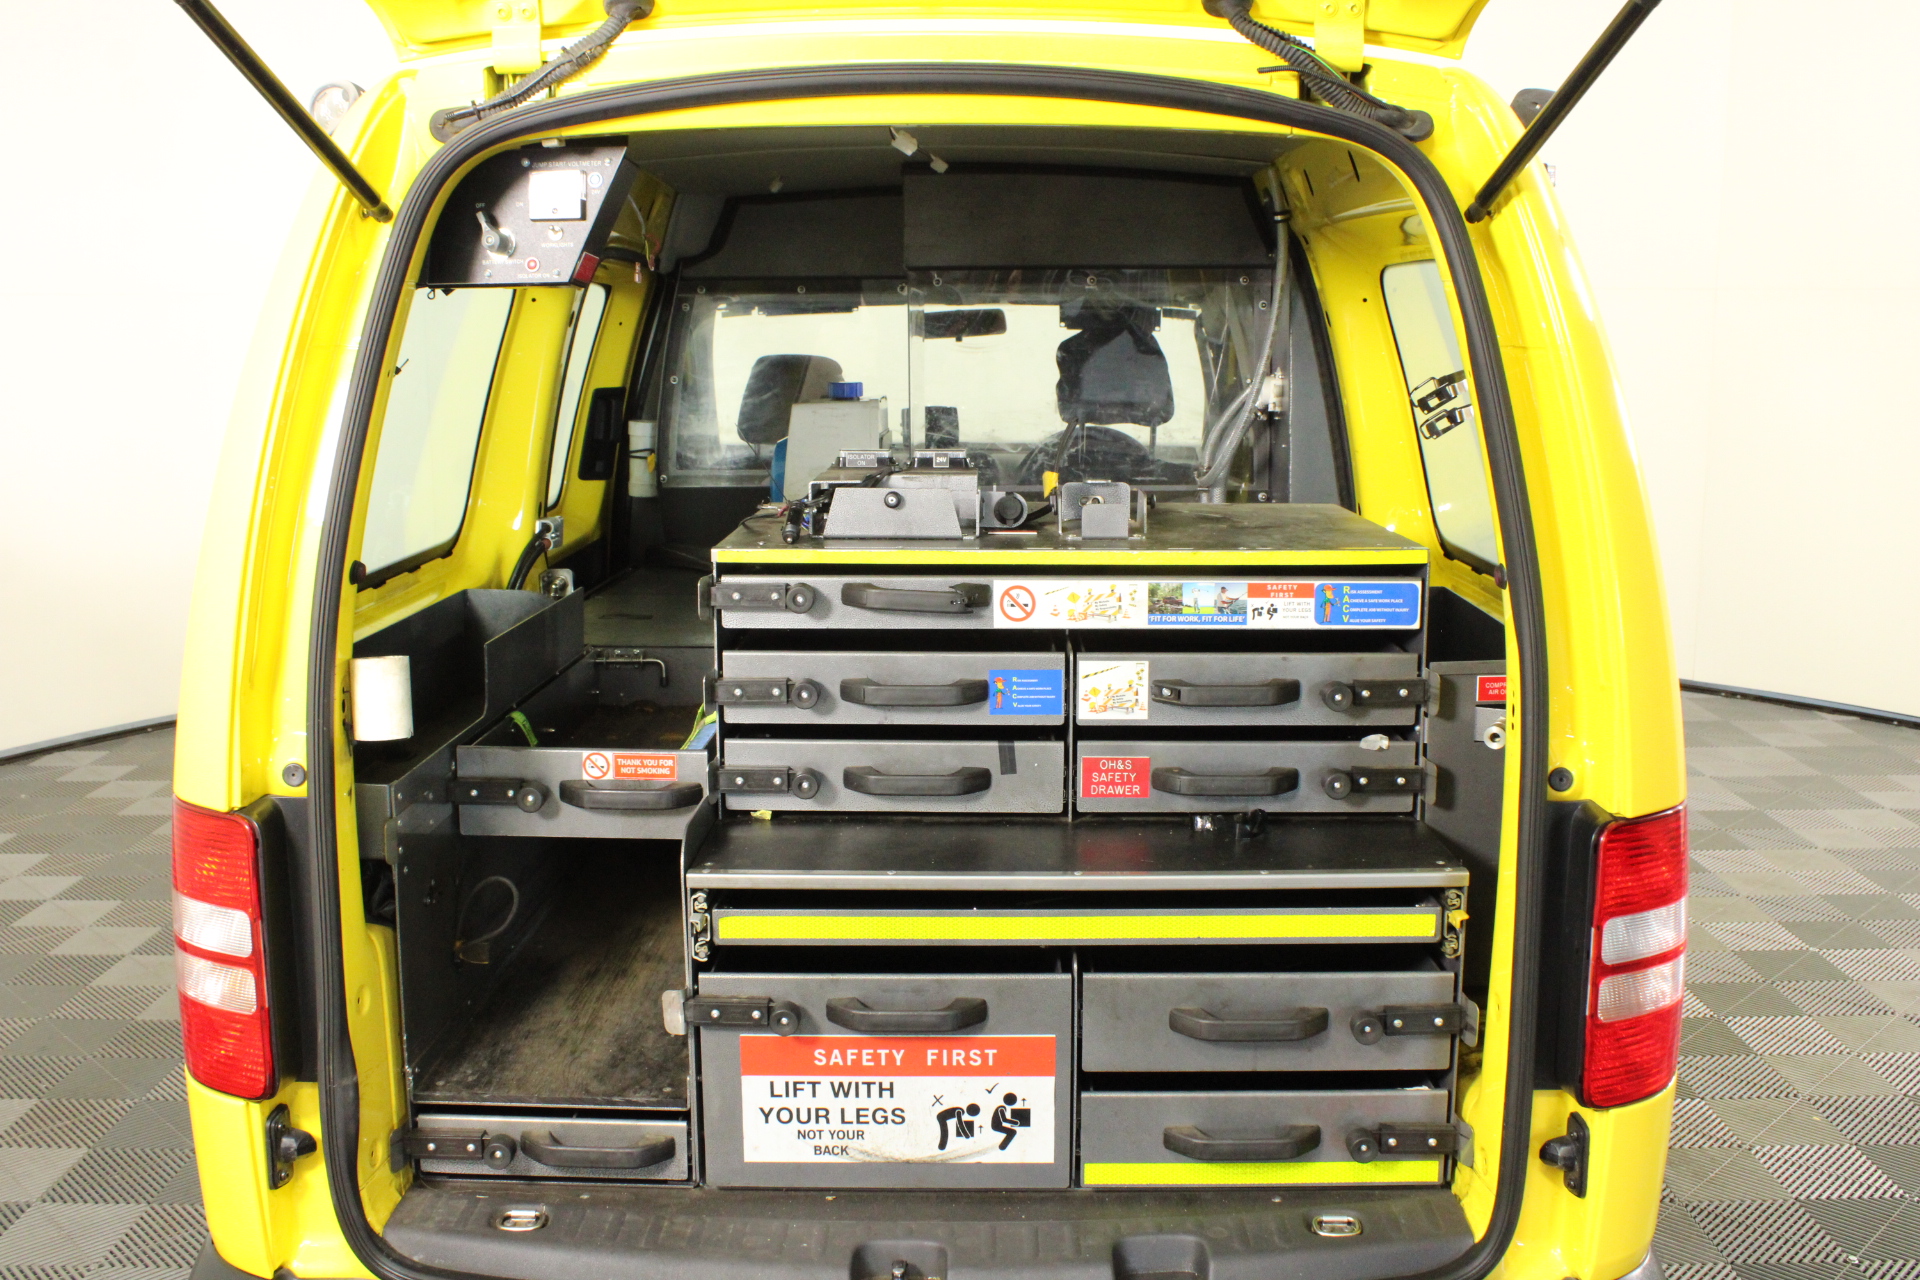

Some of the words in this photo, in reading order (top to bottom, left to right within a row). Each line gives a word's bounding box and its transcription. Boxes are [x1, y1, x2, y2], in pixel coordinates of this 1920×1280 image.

[1177, 615, 1200, 623] WORK,
[616, 758, 642, 766] THANK
[642, 758, 658, 766] YOU
[659, 759, 674, 767] FOR
[1099, 759, 1133, 770] OH&S
[637, 767, 671, 775] SMOKING
[1091, 772, 1137, 782] SAFETY
[1090, 785, 1141, 795] DRAWER
[813, 1049, 905, 1066] SAFETY
[926, 1049, 998, 1066] FIRST
[769, 1080, 821, 1099] LIFT
[830, 1080, 894, 1099] WITH
[759, 1106, 831, 1125] YOUR
[840, 1106, 906, 1125] LEGS
[796, 1129, 825, 1141] NOT
[828, 1129, 865, 1141] YOUR
[813, 1145, 849, 1156] BACK
